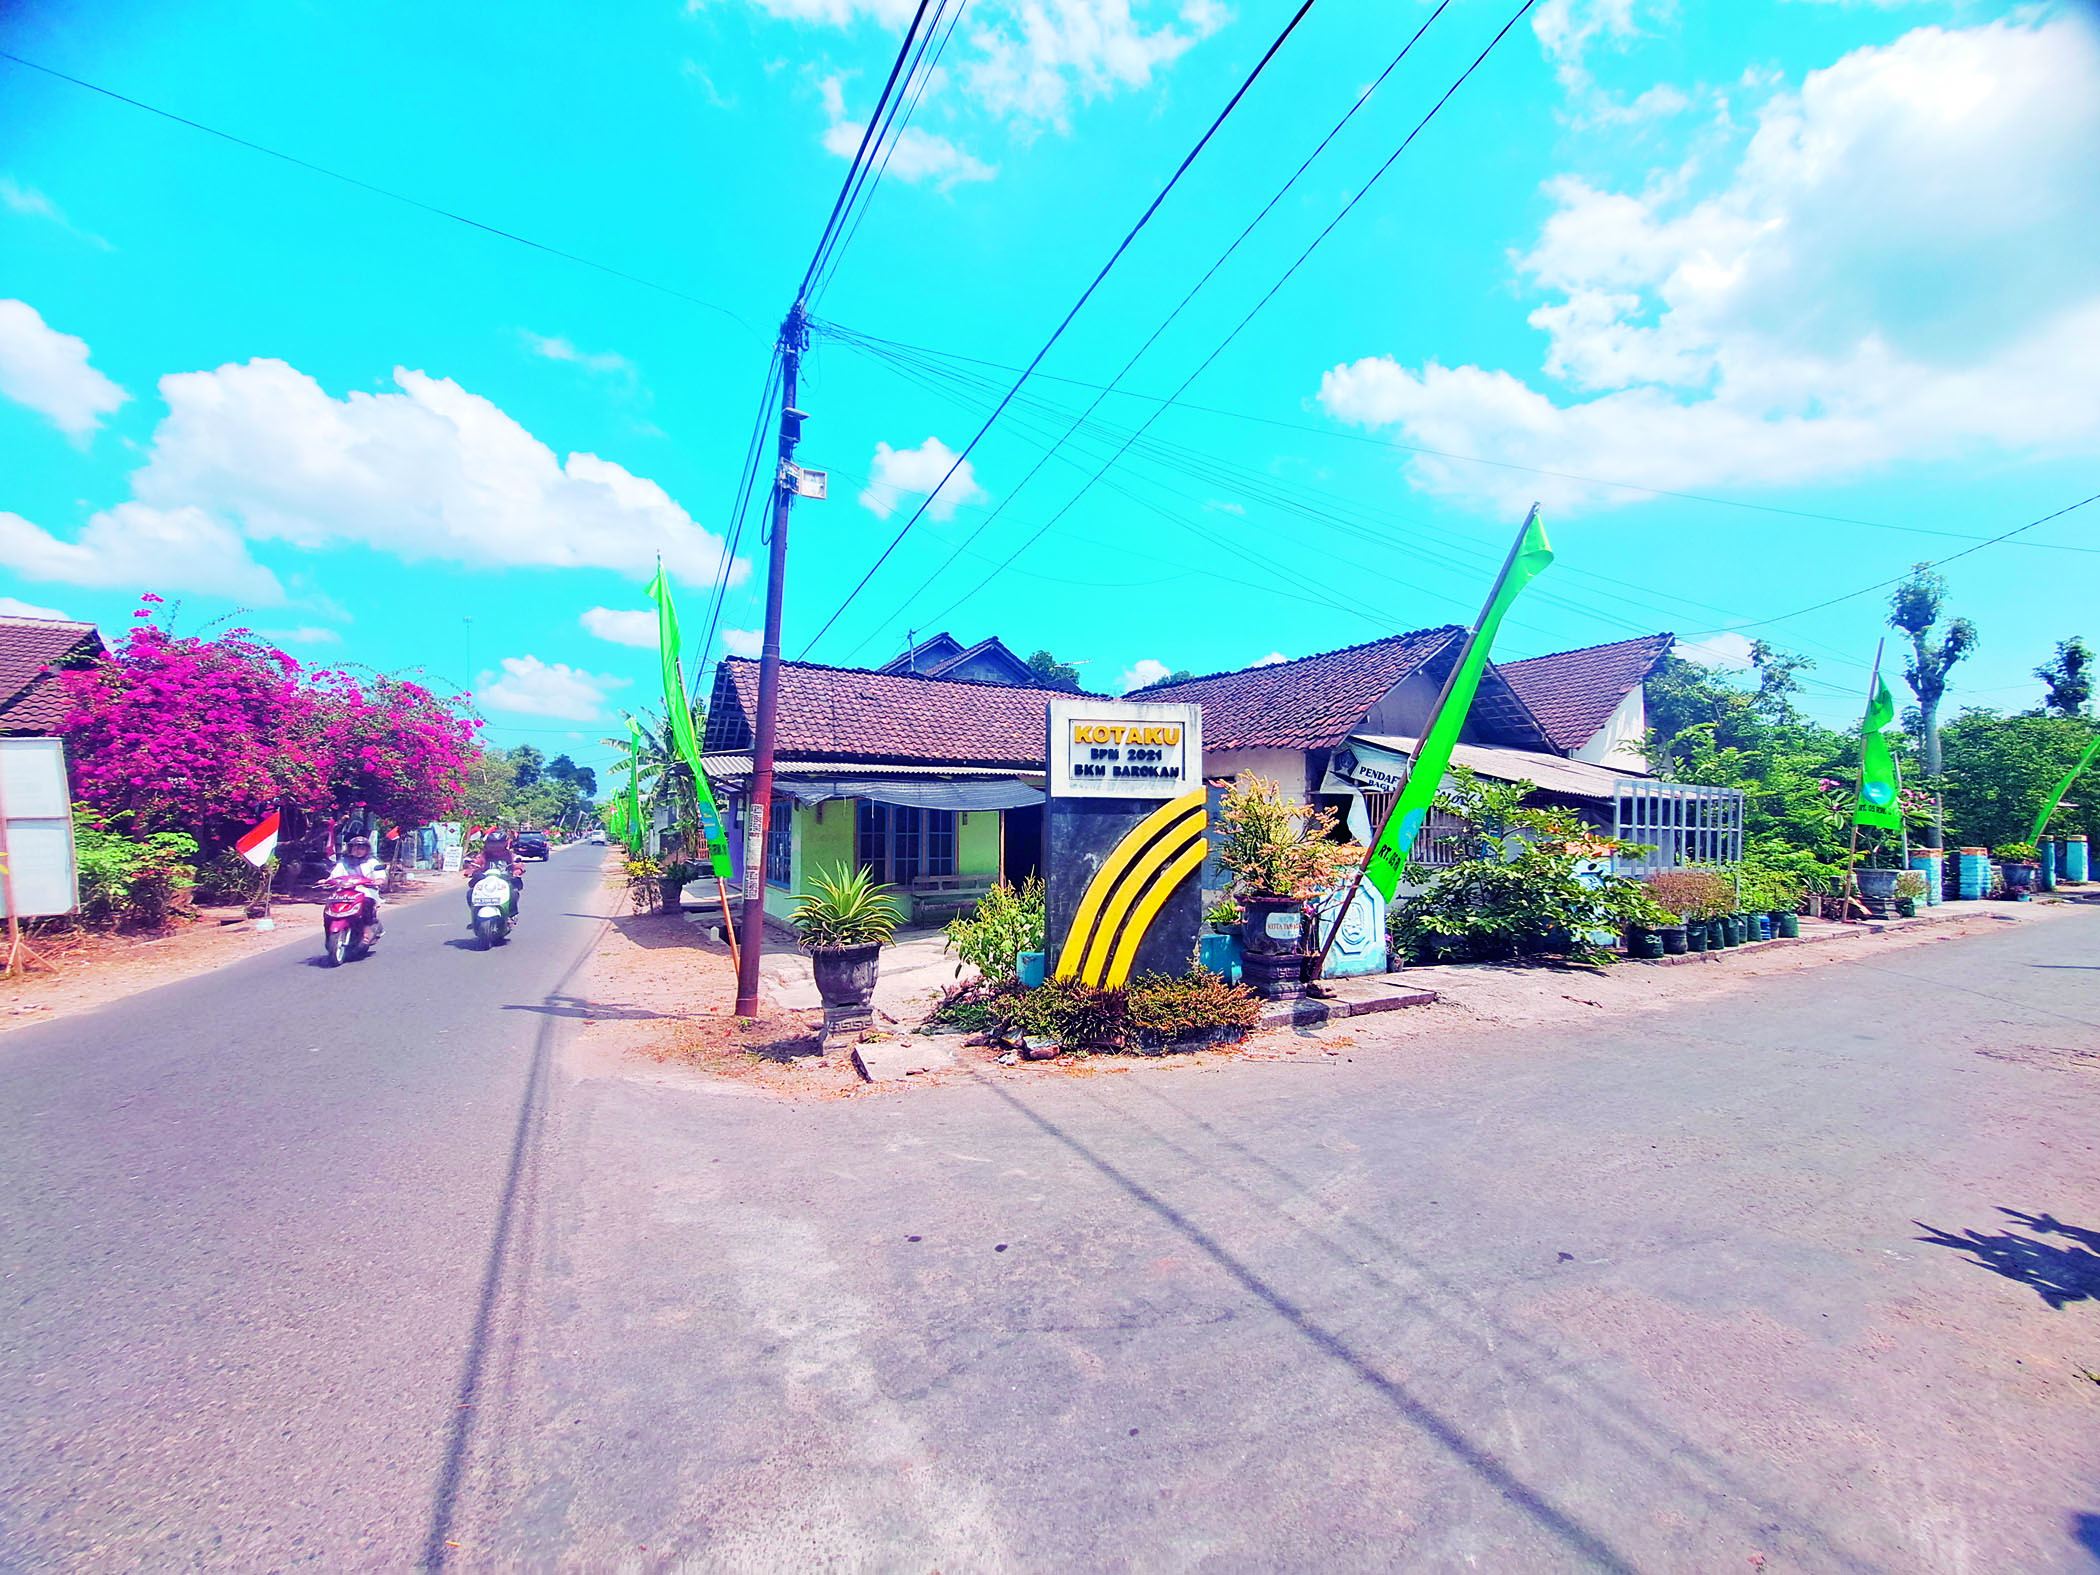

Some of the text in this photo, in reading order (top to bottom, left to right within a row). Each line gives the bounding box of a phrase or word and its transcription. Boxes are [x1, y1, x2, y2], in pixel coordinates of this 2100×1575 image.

[1074, 725, 1180, 746] KOTAKU
[1090, 748, 1163, 761] BPM 2021
[1074, 764, 1180, 778] BKM BAROKAH
